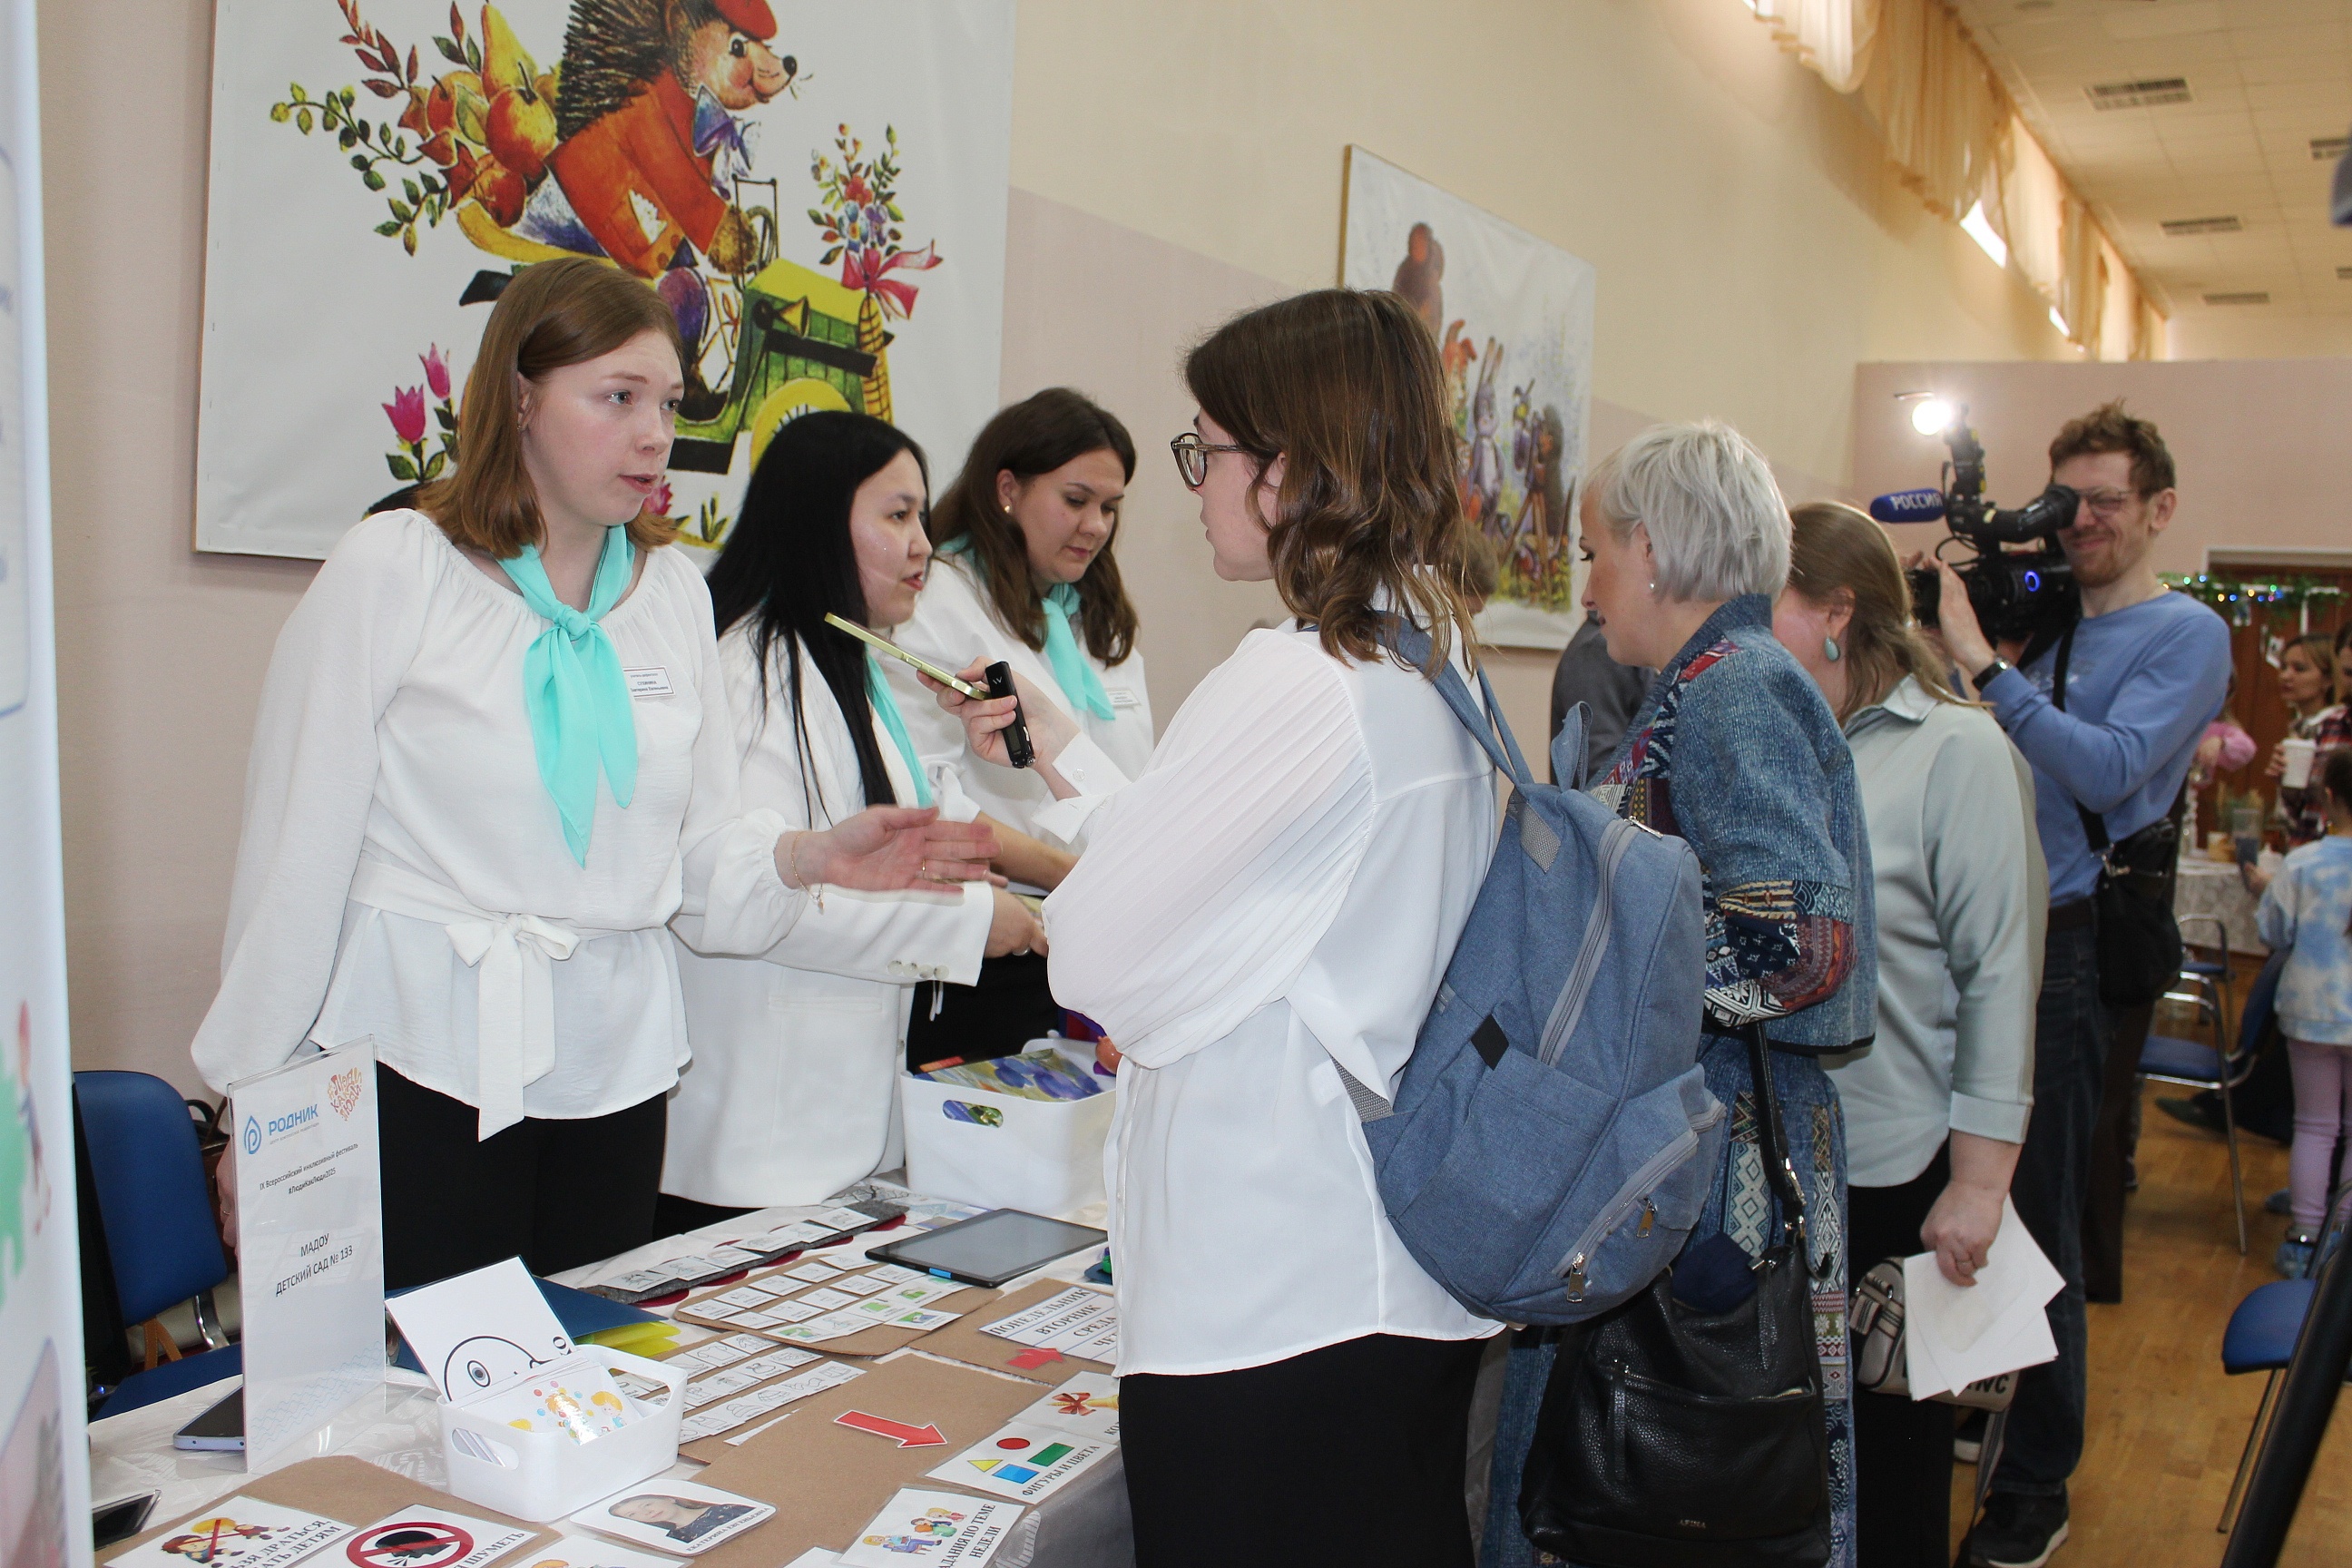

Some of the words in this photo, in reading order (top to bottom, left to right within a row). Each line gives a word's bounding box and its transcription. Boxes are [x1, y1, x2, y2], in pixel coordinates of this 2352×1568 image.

[1889, 493, 1943, 511] РОССИЯ
[269, 1103, 318, 1136] РОДНИК
[266, 1166, 303, 1189] Всероссийский
[335, 1142, 359, 1161] фестиваль
[300, 1233, 329, 1258] МАДОУ
[276, 1263, 312, 1298] ДЕТСКИЙ
[313, 1258, 329, 1273] САД
[330, 1253, 339, 1267] №
[340, 1245, 353, 1260] 133
[989, 1289, 1091, 1336] ПОНЕДЕЛЬНИК
[1034, 1304, 1102, 1335] ВТОРНИК
[1073, 1316, 1117, 1337] СРЕДА
[1104, 1421, 1120, 1436] КО
[1022, 1469, 1065, 1496] ФИГУРЫ
[1066, 1446, 1101, 1465] ЦВЕТА
[686, 1528, 729, 1552] ЕКАТЕРИНА
[728, 1506, 770, 1530] ЕВГЕНЬЕВНА
[970, 1503, 996, 1524] ТЕМЕ
[260, 1519, 332, 1556] ДРАТЬСЯ,
[290, 1525, 342, 1553] ДЕТЯМ
[962, 1524, 980, 1539] ПО
[968, 1525, 1002, 1559] НЕДЕЛИ
[463, 1533, 524, 1565] ШУМЕТЬ
[938, 1537, 972, 1568] ДАНИЯ
